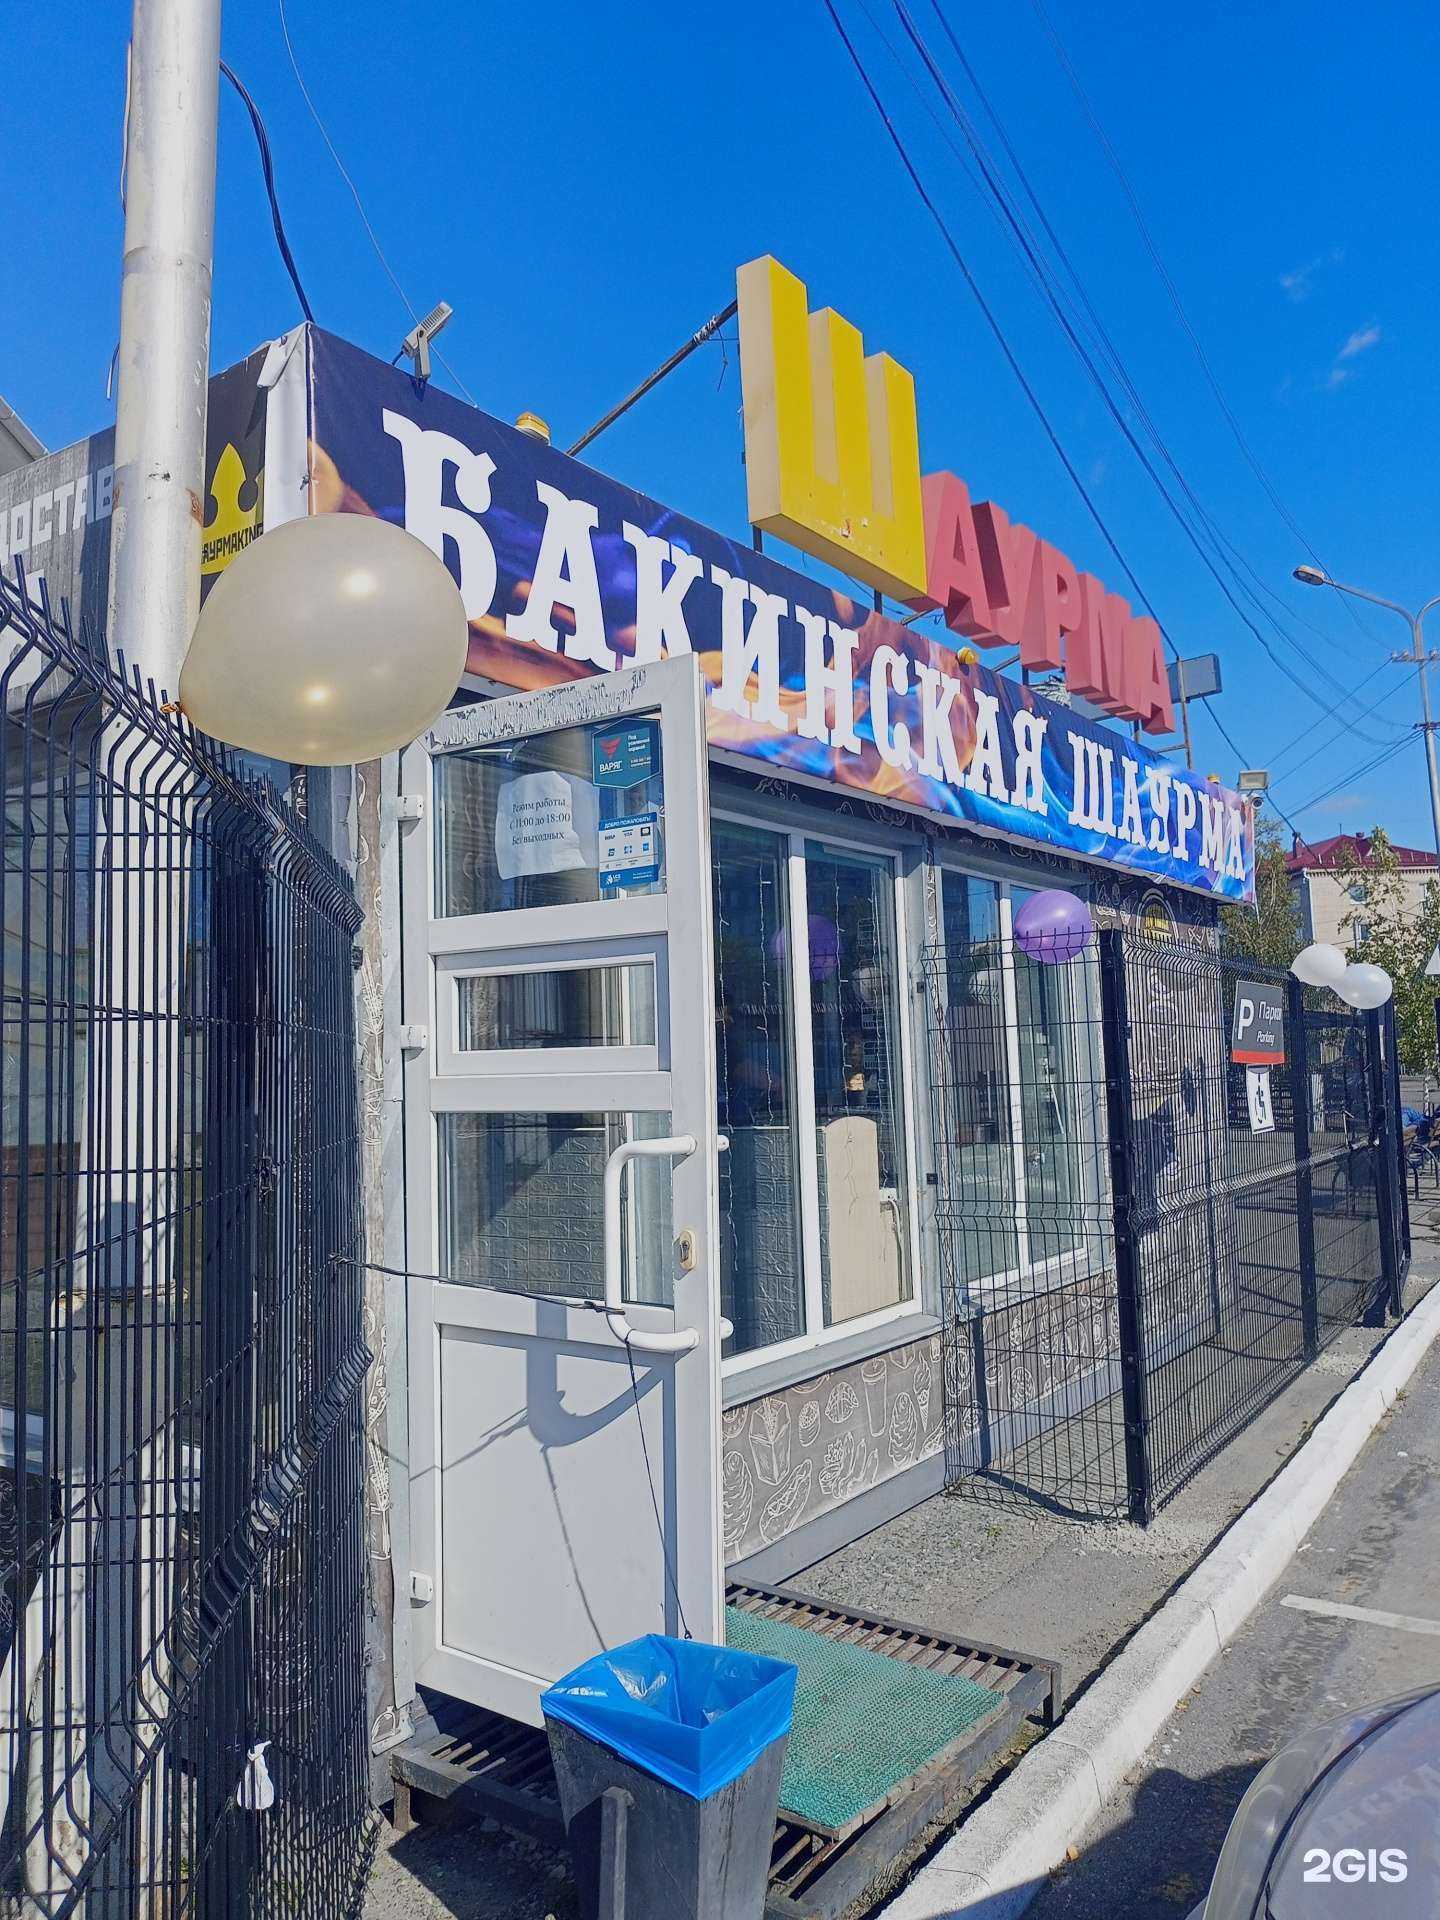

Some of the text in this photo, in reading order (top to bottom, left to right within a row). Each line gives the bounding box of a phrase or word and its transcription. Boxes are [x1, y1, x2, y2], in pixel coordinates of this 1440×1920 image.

[736, 254, 1175, 734] ШАУРМА
[0, 464, 113, 567] ОСТАВ
[201, 523, 264, 565] АУРМАKING
[382, 408, 1246, 879] БАКИНСКАЯ ШАУРМА
[600, 760, 623, 772] ВАРЯГ
[512, 797, 566, 813] Режим работы
[546, 812, 571, 824] 18:00
[523, 831, 565, 844] выходных
[1237, 998, 1255, 1040] P
[1256, 1030, 1275, 1046] Parking
